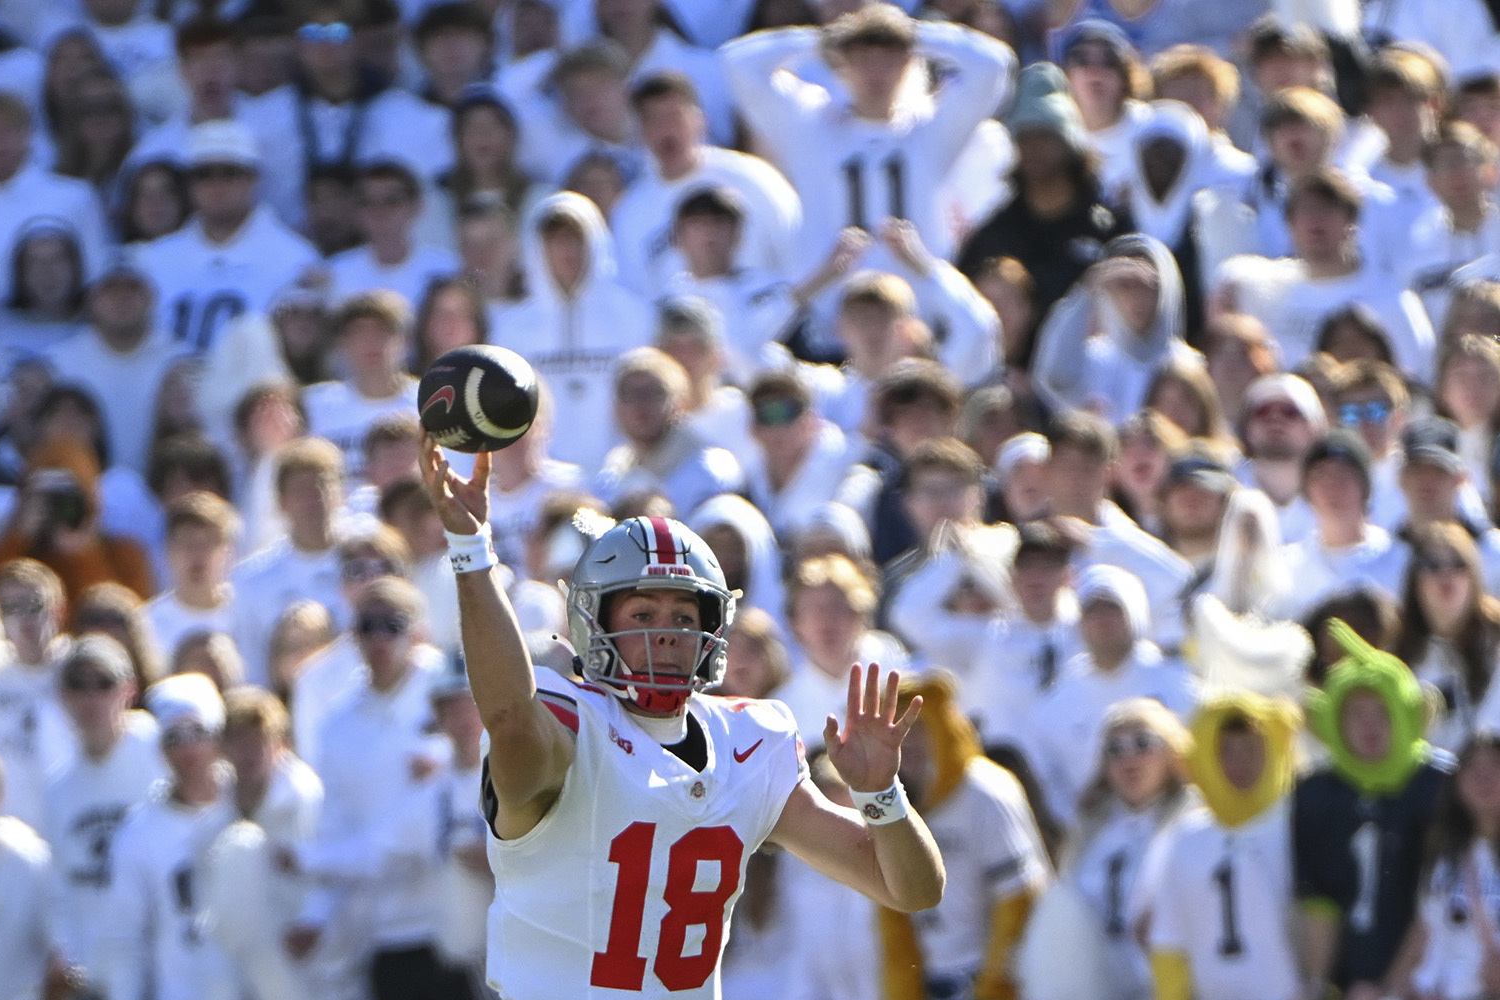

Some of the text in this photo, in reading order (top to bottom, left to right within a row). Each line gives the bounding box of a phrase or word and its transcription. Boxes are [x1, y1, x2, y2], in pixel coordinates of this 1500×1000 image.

[590, 821, 744, 992] 18
[1212, 858, 1246, 957] 1
[1351, 821, 1380, 931] 1
